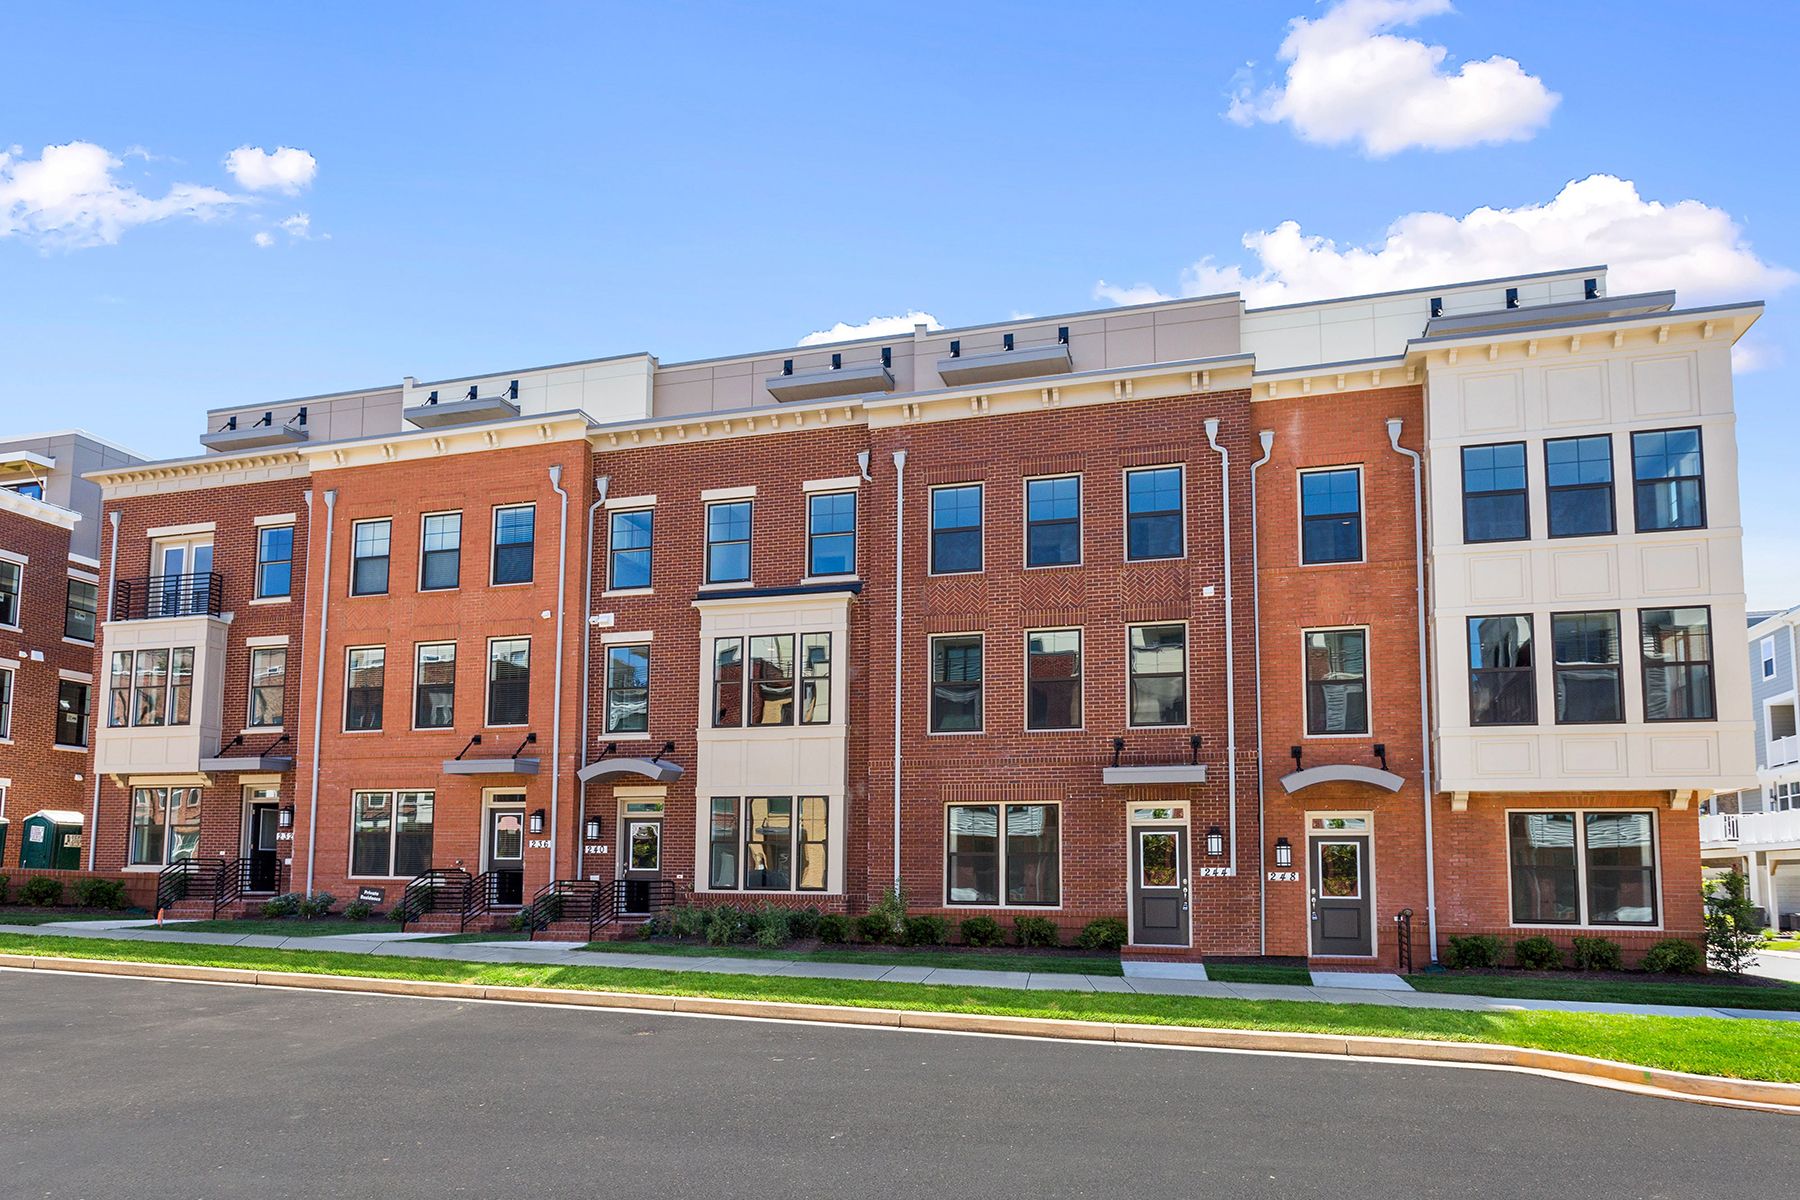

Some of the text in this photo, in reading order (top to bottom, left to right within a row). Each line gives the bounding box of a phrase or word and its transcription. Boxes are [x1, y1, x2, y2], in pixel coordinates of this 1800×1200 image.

[531, 840, 549, 848] 236
[587, 845, 605, 853] 240
[1204, 867, 1227, 877] 244
[1270, 872, 1296, 881] 248
